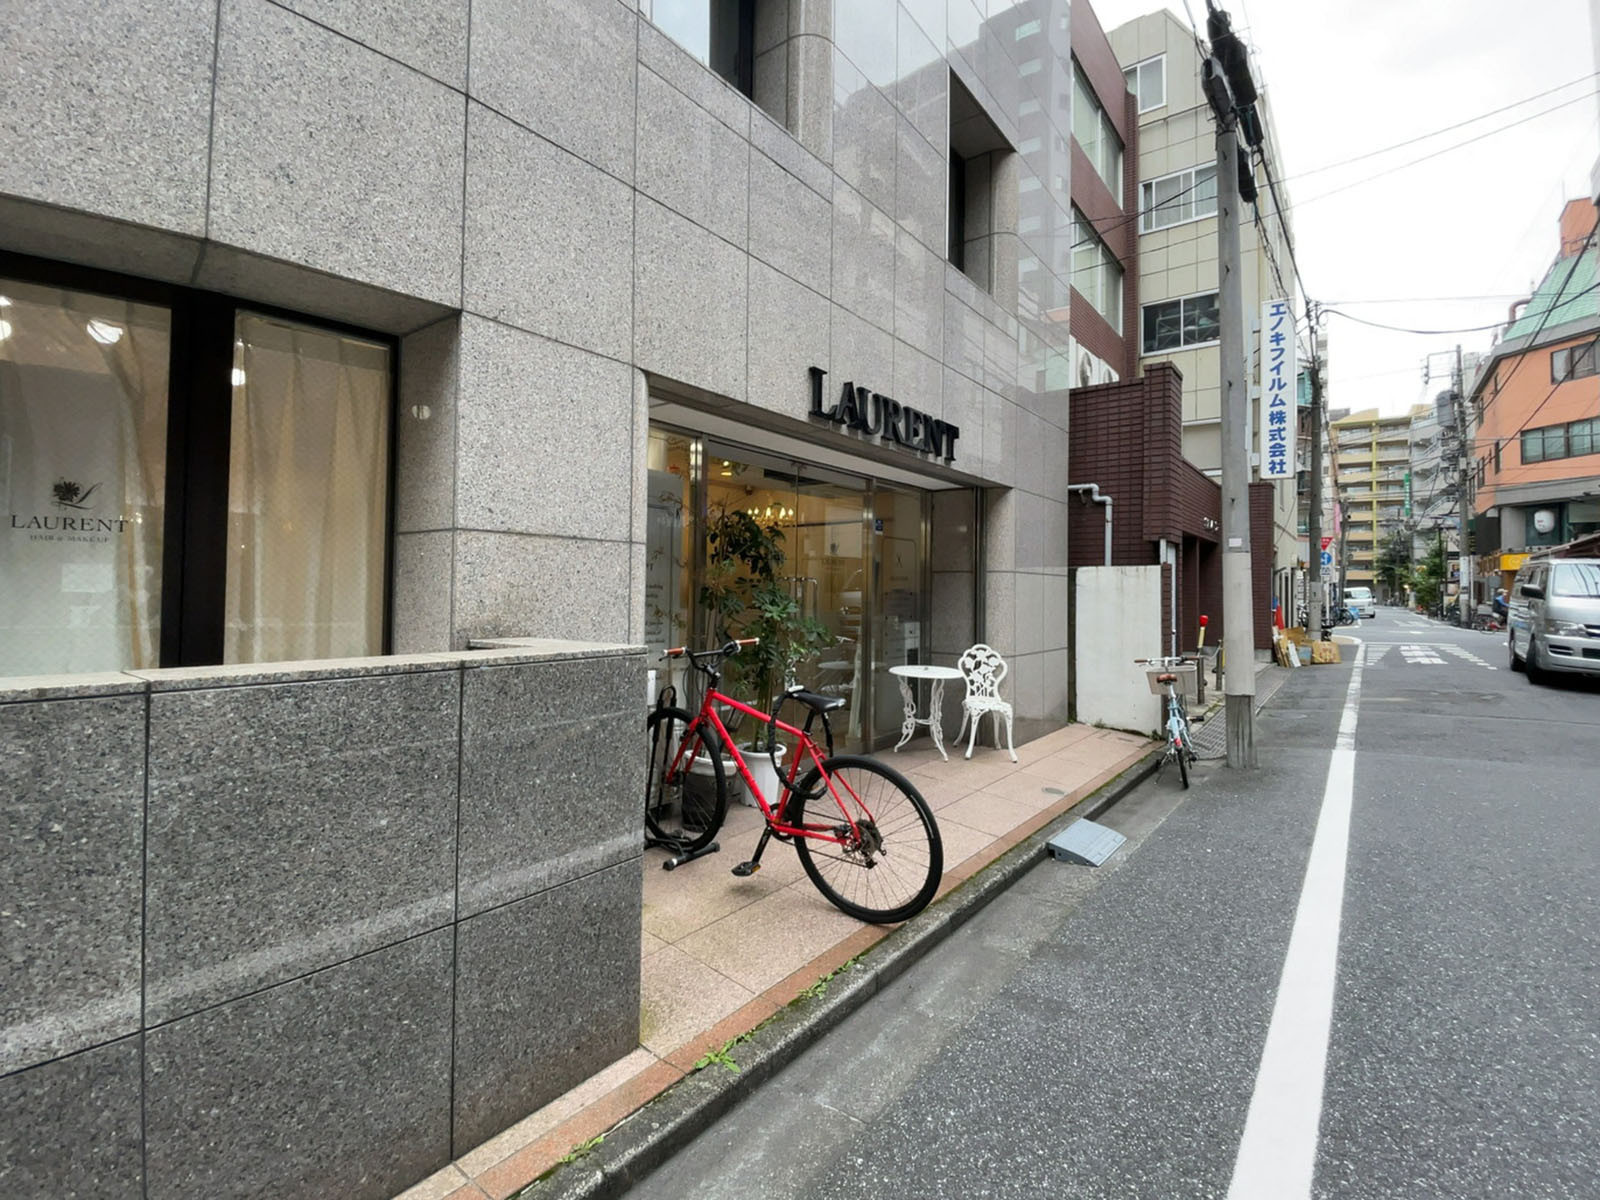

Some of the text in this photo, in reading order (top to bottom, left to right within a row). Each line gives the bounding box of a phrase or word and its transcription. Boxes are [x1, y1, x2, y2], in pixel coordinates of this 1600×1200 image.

[808, 366, 960, 461] LAURENT
[1268, 303, 1287, 475] エノキフイルム株式会社
[11, 514, 128, 533] LAURENT
